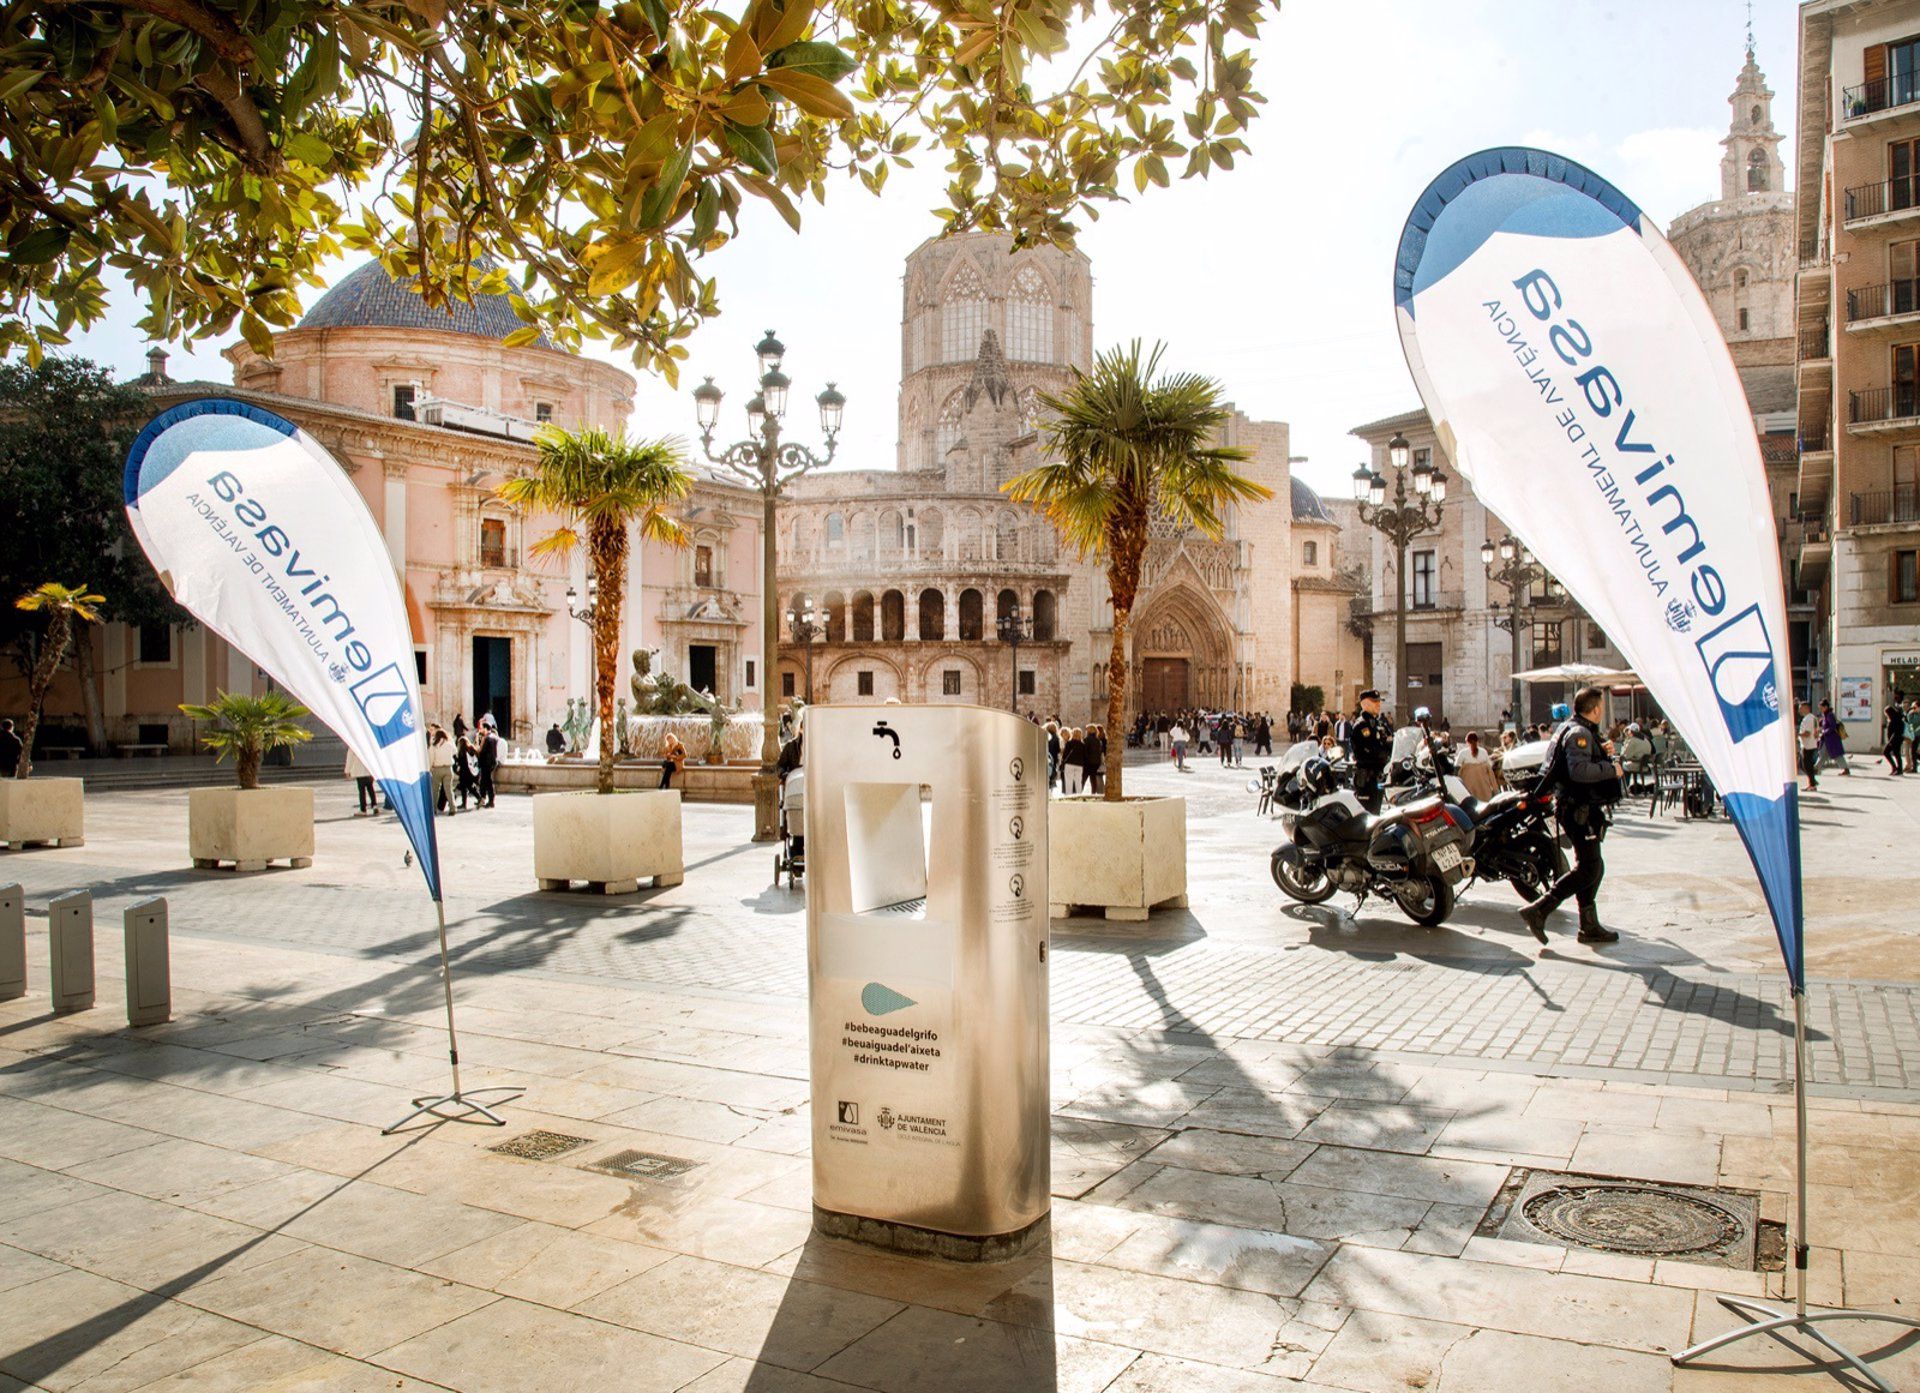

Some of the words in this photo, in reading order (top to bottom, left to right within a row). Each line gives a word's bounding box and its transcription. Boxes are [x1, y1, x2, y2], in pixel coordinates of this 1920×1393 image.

[1890, 656, 1920, 664] HELAD
[845, 1022, 938, 1041] #bebeaguadelgrifo
[854, 1054, 929, 1071] #drinktapwater
[897, 1114, 946, 1127] AJUNTAMENT
[829, 1124, 867, 1135] emivasa
[897, 1123, 908, 1132] DE
